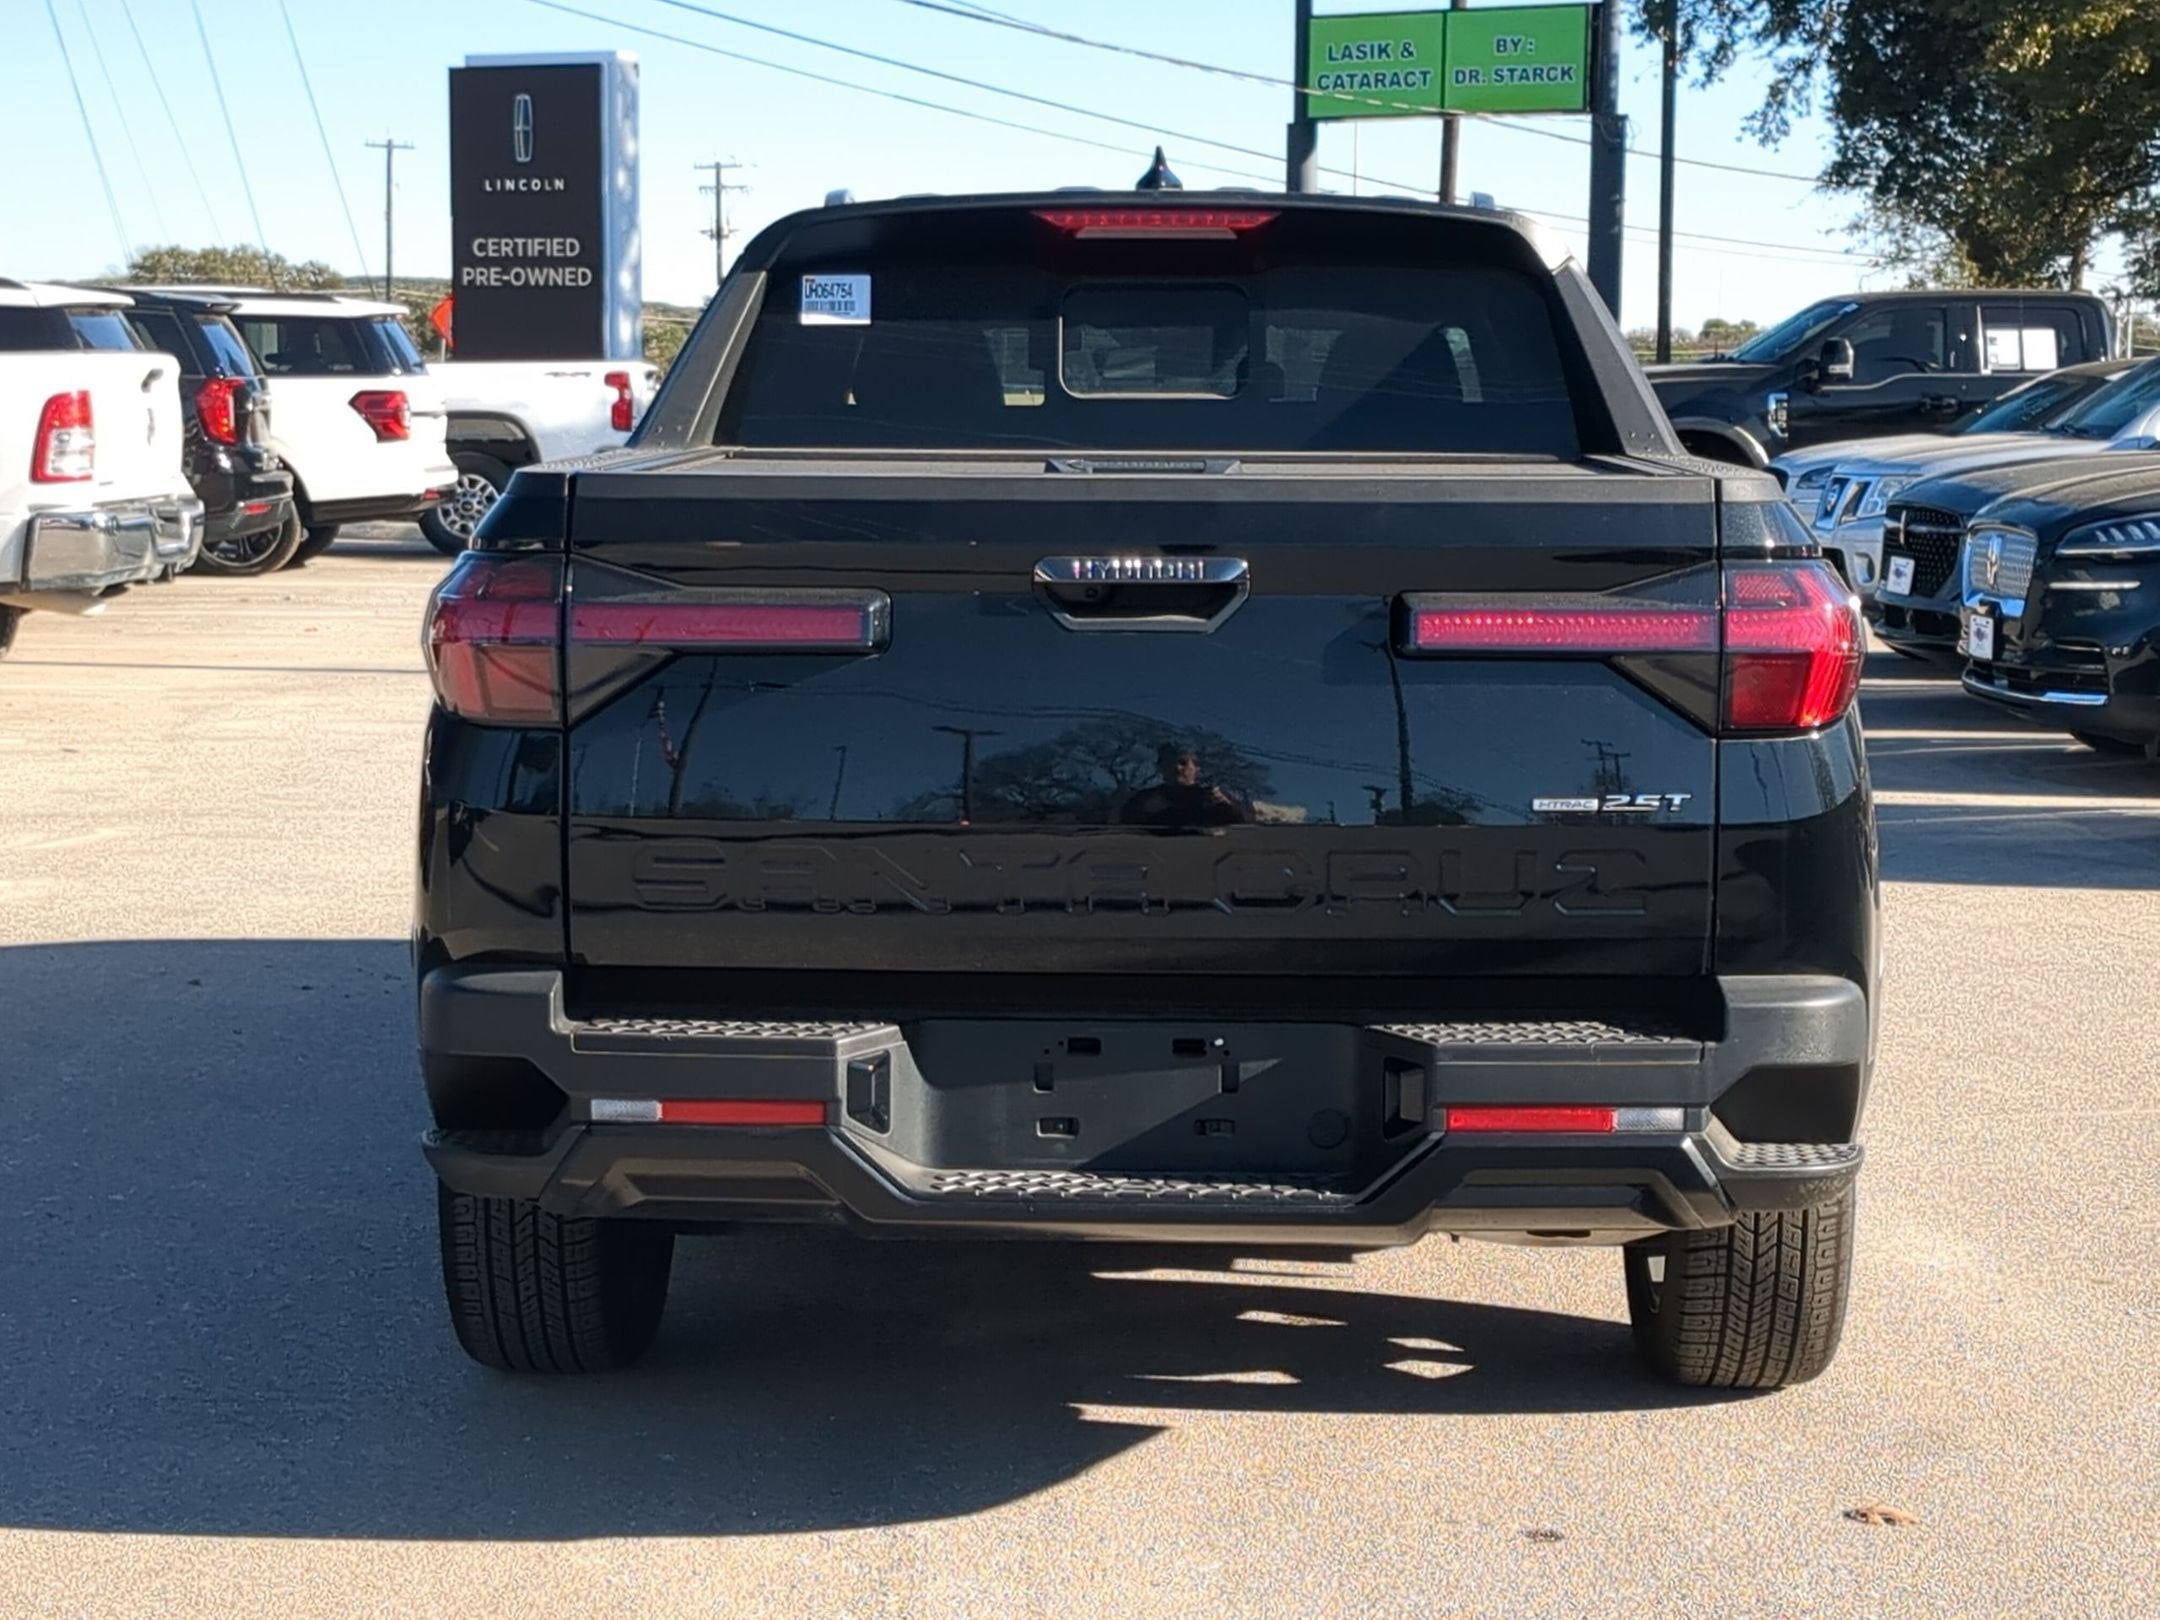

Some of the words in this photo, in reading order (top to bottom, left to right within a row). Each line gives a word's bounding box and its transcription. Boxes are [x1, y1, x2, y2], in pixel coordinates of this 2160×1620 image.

[1327, 42, 1392, 62] LASIK
[1400, 41, 1416, 59] &
[1495, 37, 1535, 55] BY:
[1317, 69, 1432, 91] CATARACT
[1454, 68, 1487, 85] DR.
[1493, 65, 1575, 84] STARCK
[484, 178, 566, 192] LINCOLN
[472, 237, 581, 257] CERTIFIED
[462, 266, 593, 287] PRE-OWNED
[1536, 799, 1595, 810] HTRAC
[632, 844, 1170, 914] SANTA
[1212, 847, 1648, 916] CRUZ
